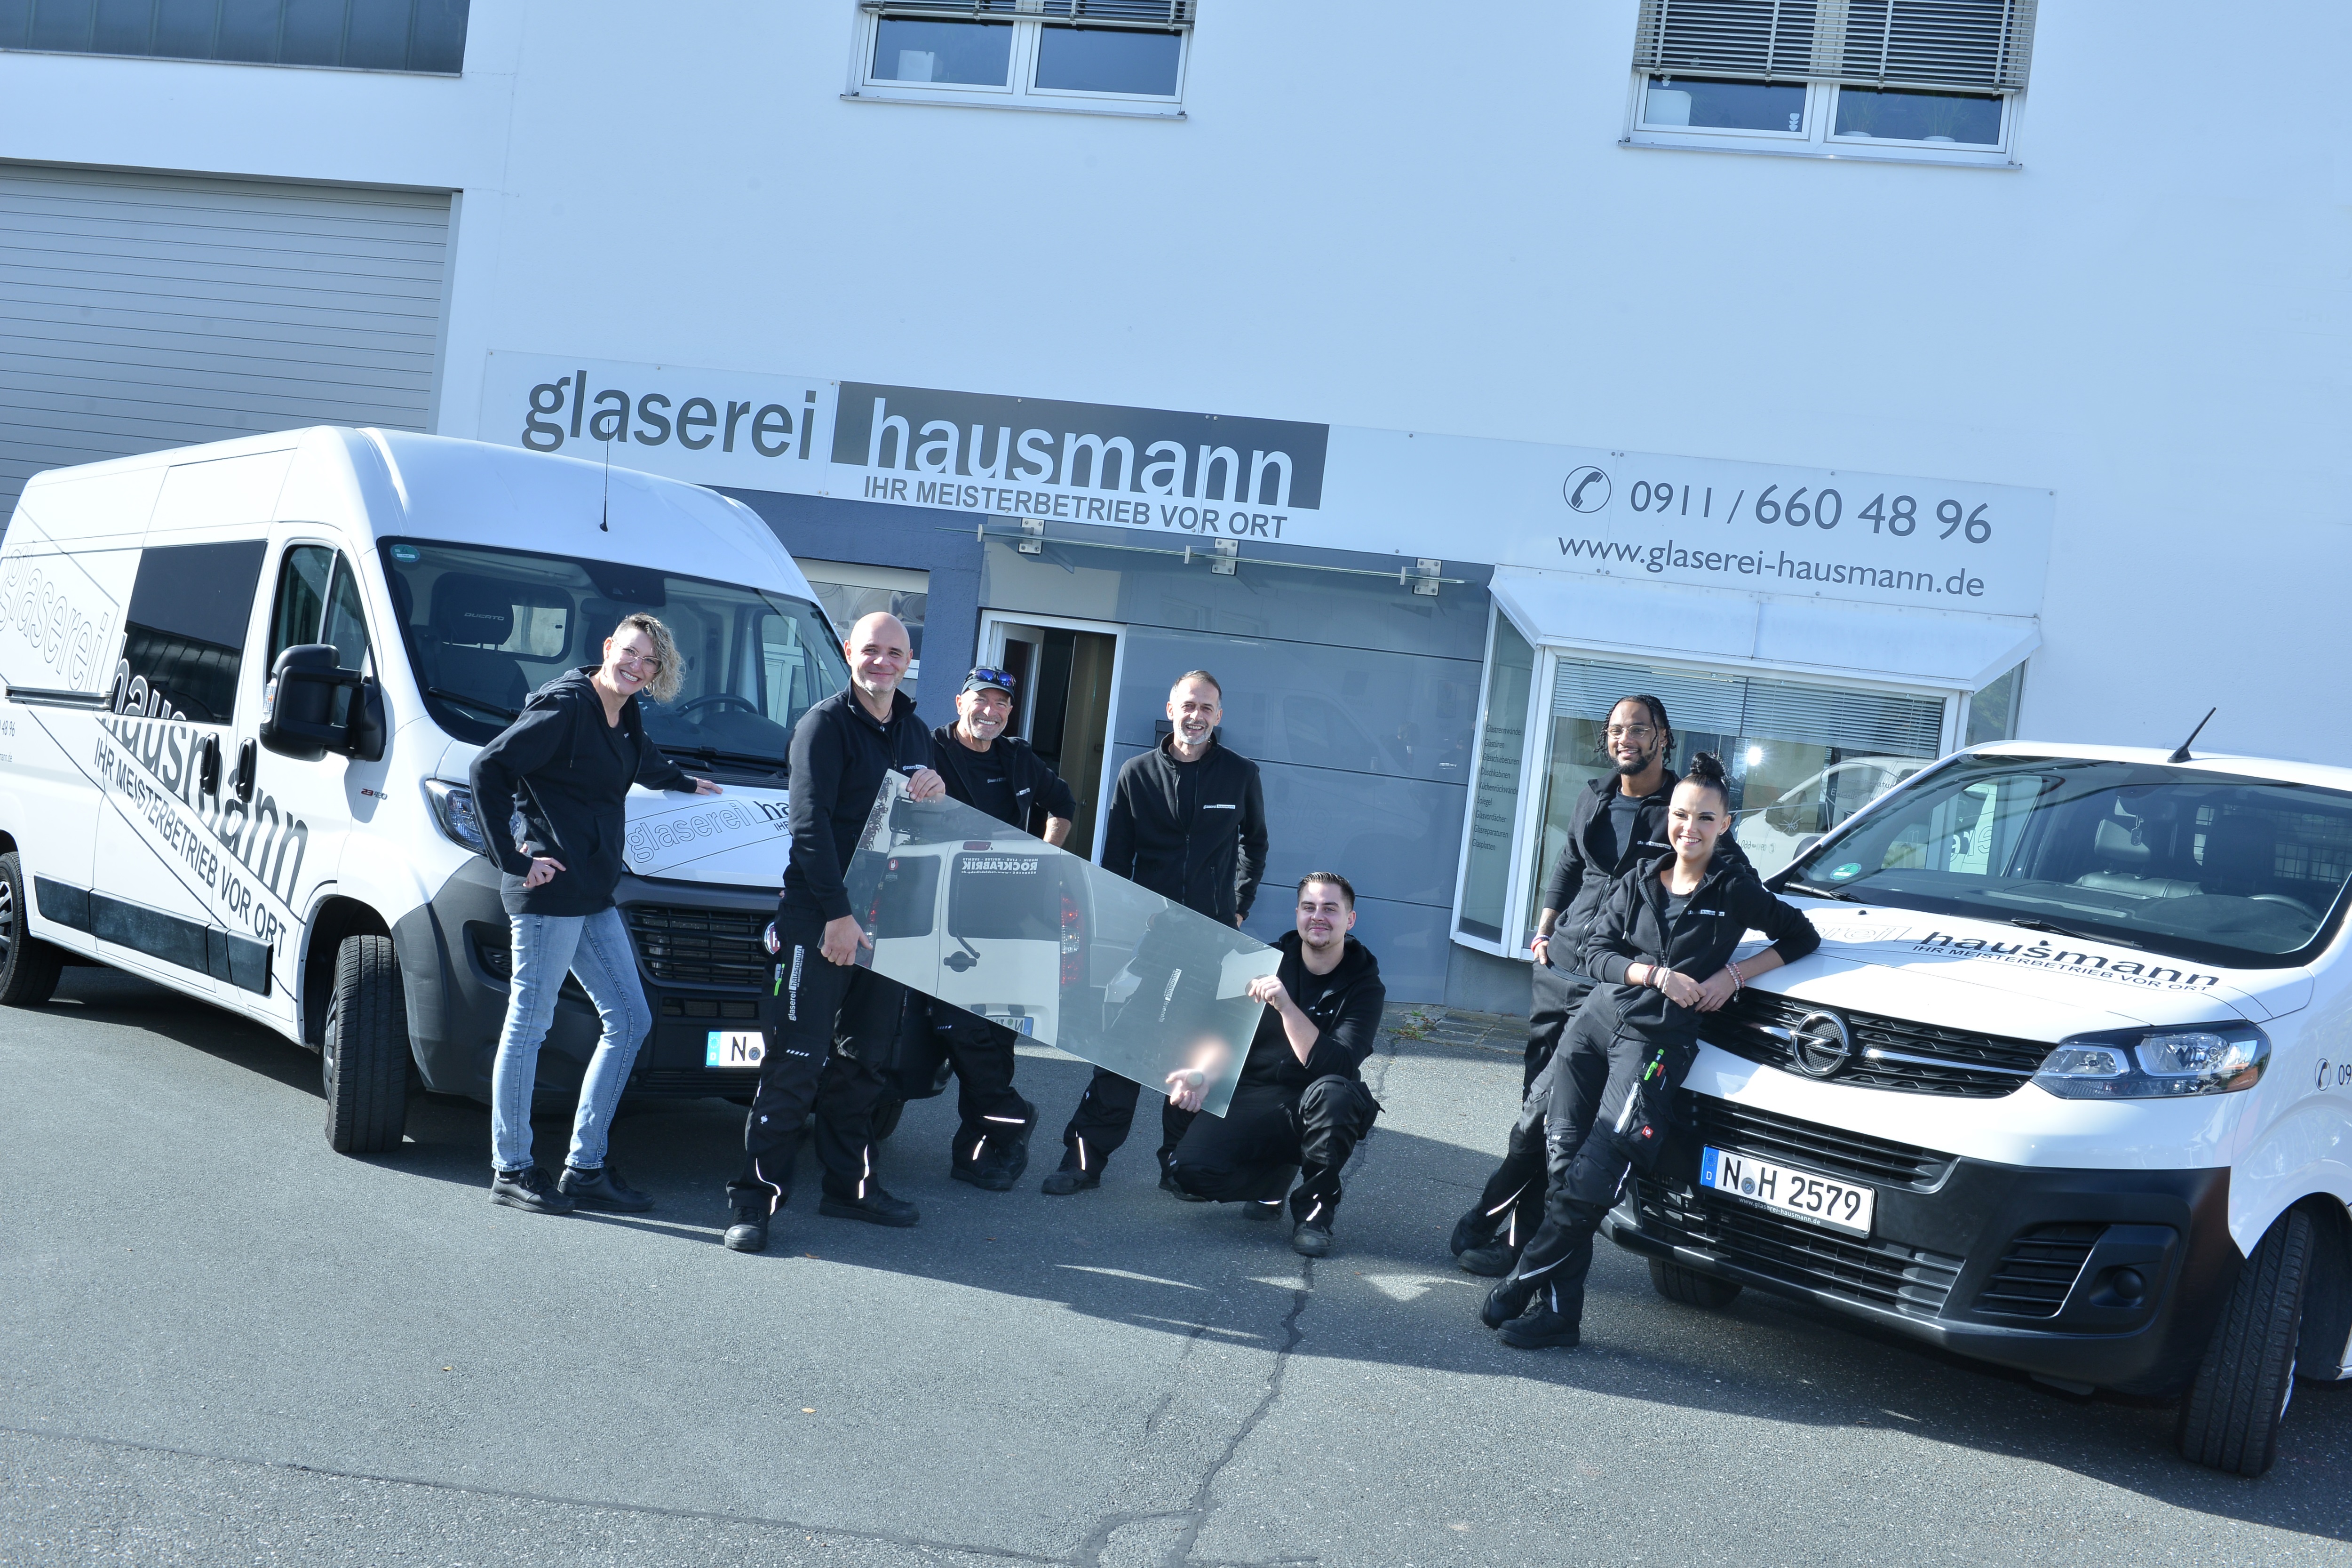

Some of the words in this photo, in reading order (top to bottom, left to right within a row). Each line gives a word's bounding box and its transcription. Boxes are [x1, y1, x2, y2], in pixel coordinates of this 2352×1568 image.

[521, 370, 817, 452] glaserei
[867, 397, 1293, 508] hausmann
[864, 476, 907, 501] IHR
[916, 481, 1150, 525] MEISTERBETRIEB
[1160, 504, 1220, 532] VOR
[1229, 512, 1287, 538] ORT
[1630, 480, 1712, 518] 0911
[1755, 484, 1843, 530] 660
[1858, 493, 1917, 536] 48
[1936, 499, 1992, 544] 96
[1557, 537, 1985, 597] www.glaserei-hausmann.de
[1, 720, 8, 735] 48
[9, 721, 16, 737] 96
[1486, 724, 1521, 735] Glastrennwände
[1484, 739, 1505, 748] Glastüren
[1483, 753, 1519, 765] Glasschiebetüren
[1480, 767, 1510, 779] Duschkabinen
[1477, 796, 1493, 807] Spiegel
[1478, 781, 1518, 795] Küchenrückwände
[1475, 810, 1507, 823] Glasvordächer
[627, 803, 750, 863] glaserei
[1474, 824, 1509, 838] Glasreparaturen
[94, 737, 114, 781] IHR
[116, 758, 218, 889] MEISTERBETRIEB
[222, 865, 251, 926] VOR
[254, 903, 286, 958] ORT
[1472, 839, 1496, 851] Glasplatten
[790, 947, 803, 987] hausmann
[1913, 945, 1944, 954] IHR
[1948, 949, 2114, 978] MEISTERBETRIEB
[2121, 975, 2161, 987] VOR
[1920, 932, 2219, 986] hausmann
[788, 990, 797, 1021] glaserei
[710, 1052, 716, 1061] D
[731, 1036, 747, 1061] N
[1706, 1171, 1712, 1180] D
[1723, 1157, 1741, 1190] N
[1758, 1167, 1777, 1200] H
[1788, 1176, 1861, 1221] 2579
[1739, 1198, 1821, 1225] www.glaserei-hausmann.de
